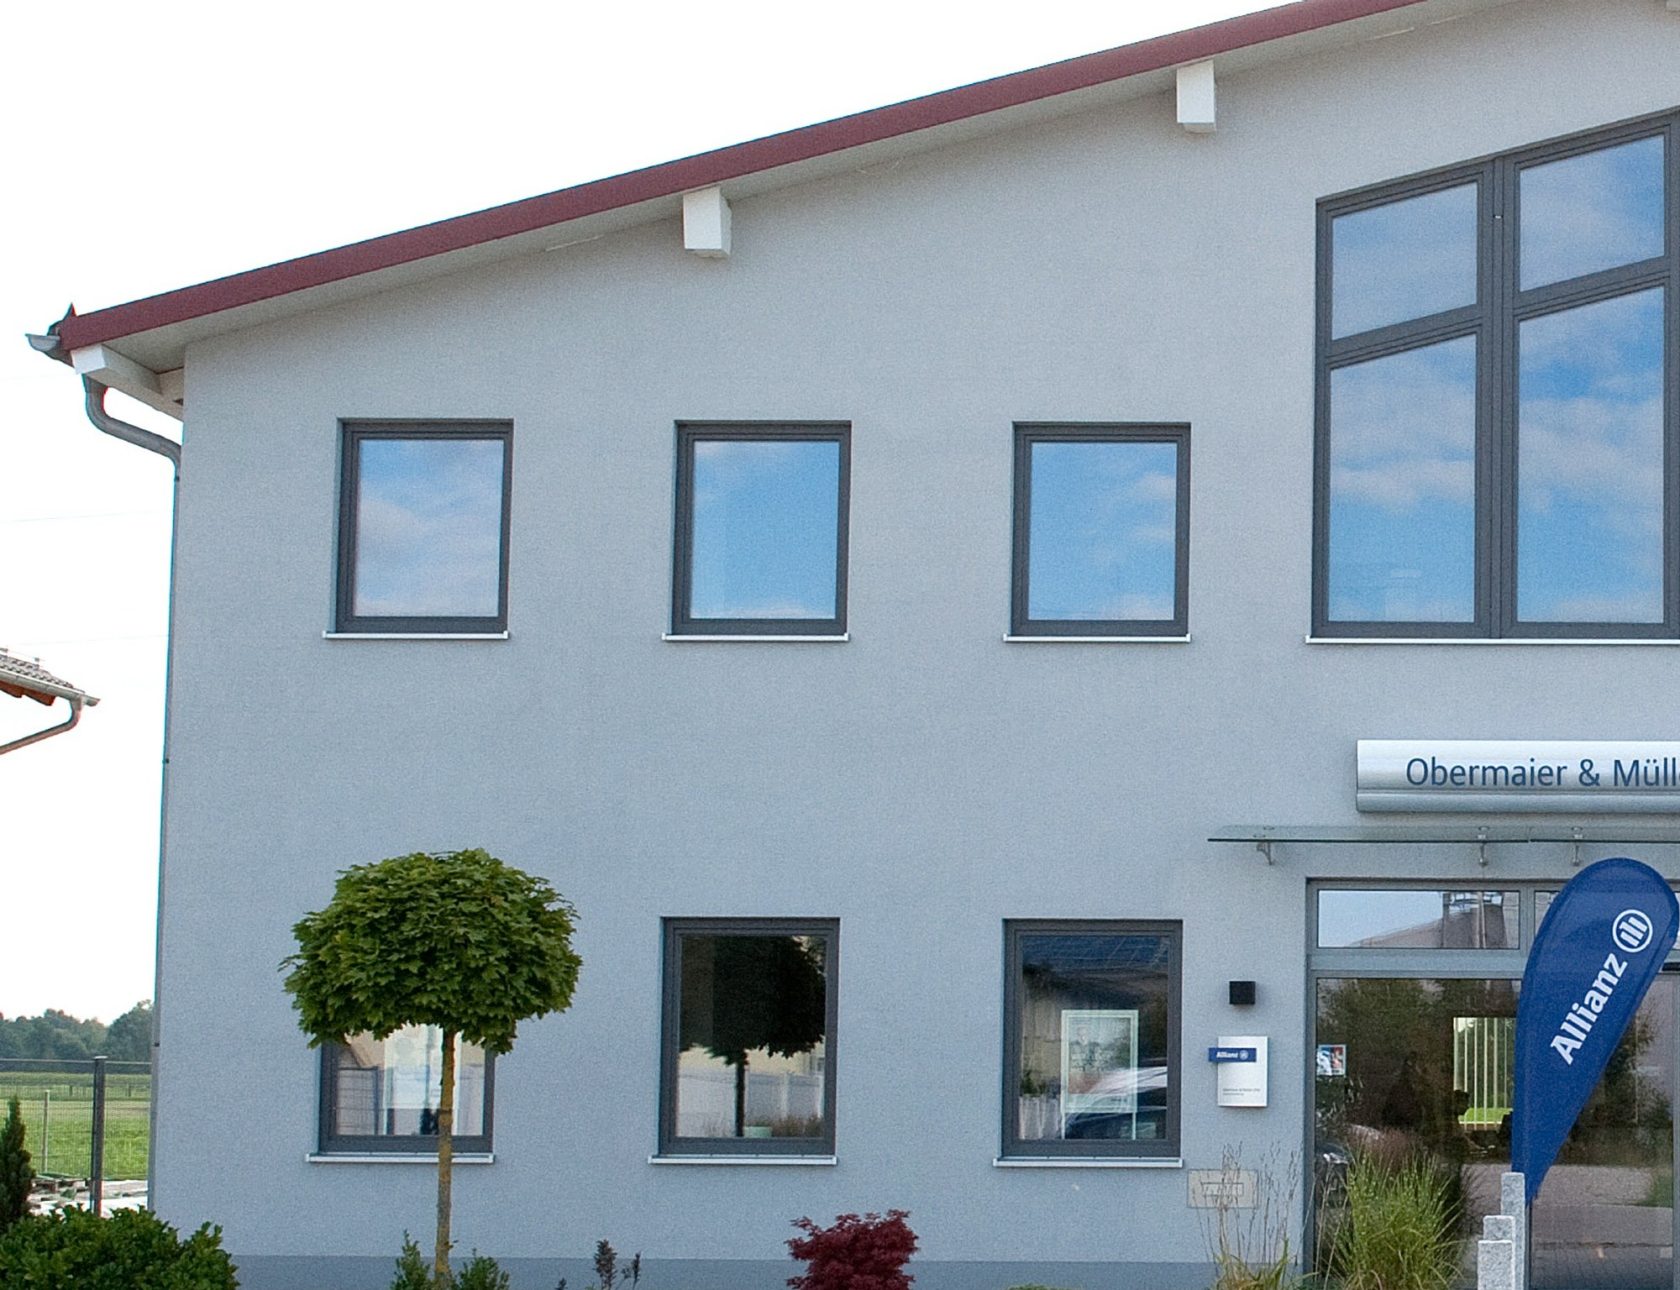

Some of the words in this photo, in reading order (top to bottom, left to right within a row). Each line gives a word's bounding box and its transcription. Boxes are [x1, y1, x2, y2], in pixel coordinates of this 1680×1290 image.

[1406, 757, 1567, 787] Obermaier
[1578, 759, 1600, 787] &
[1550, 953, 1628, 1065] Allianz
